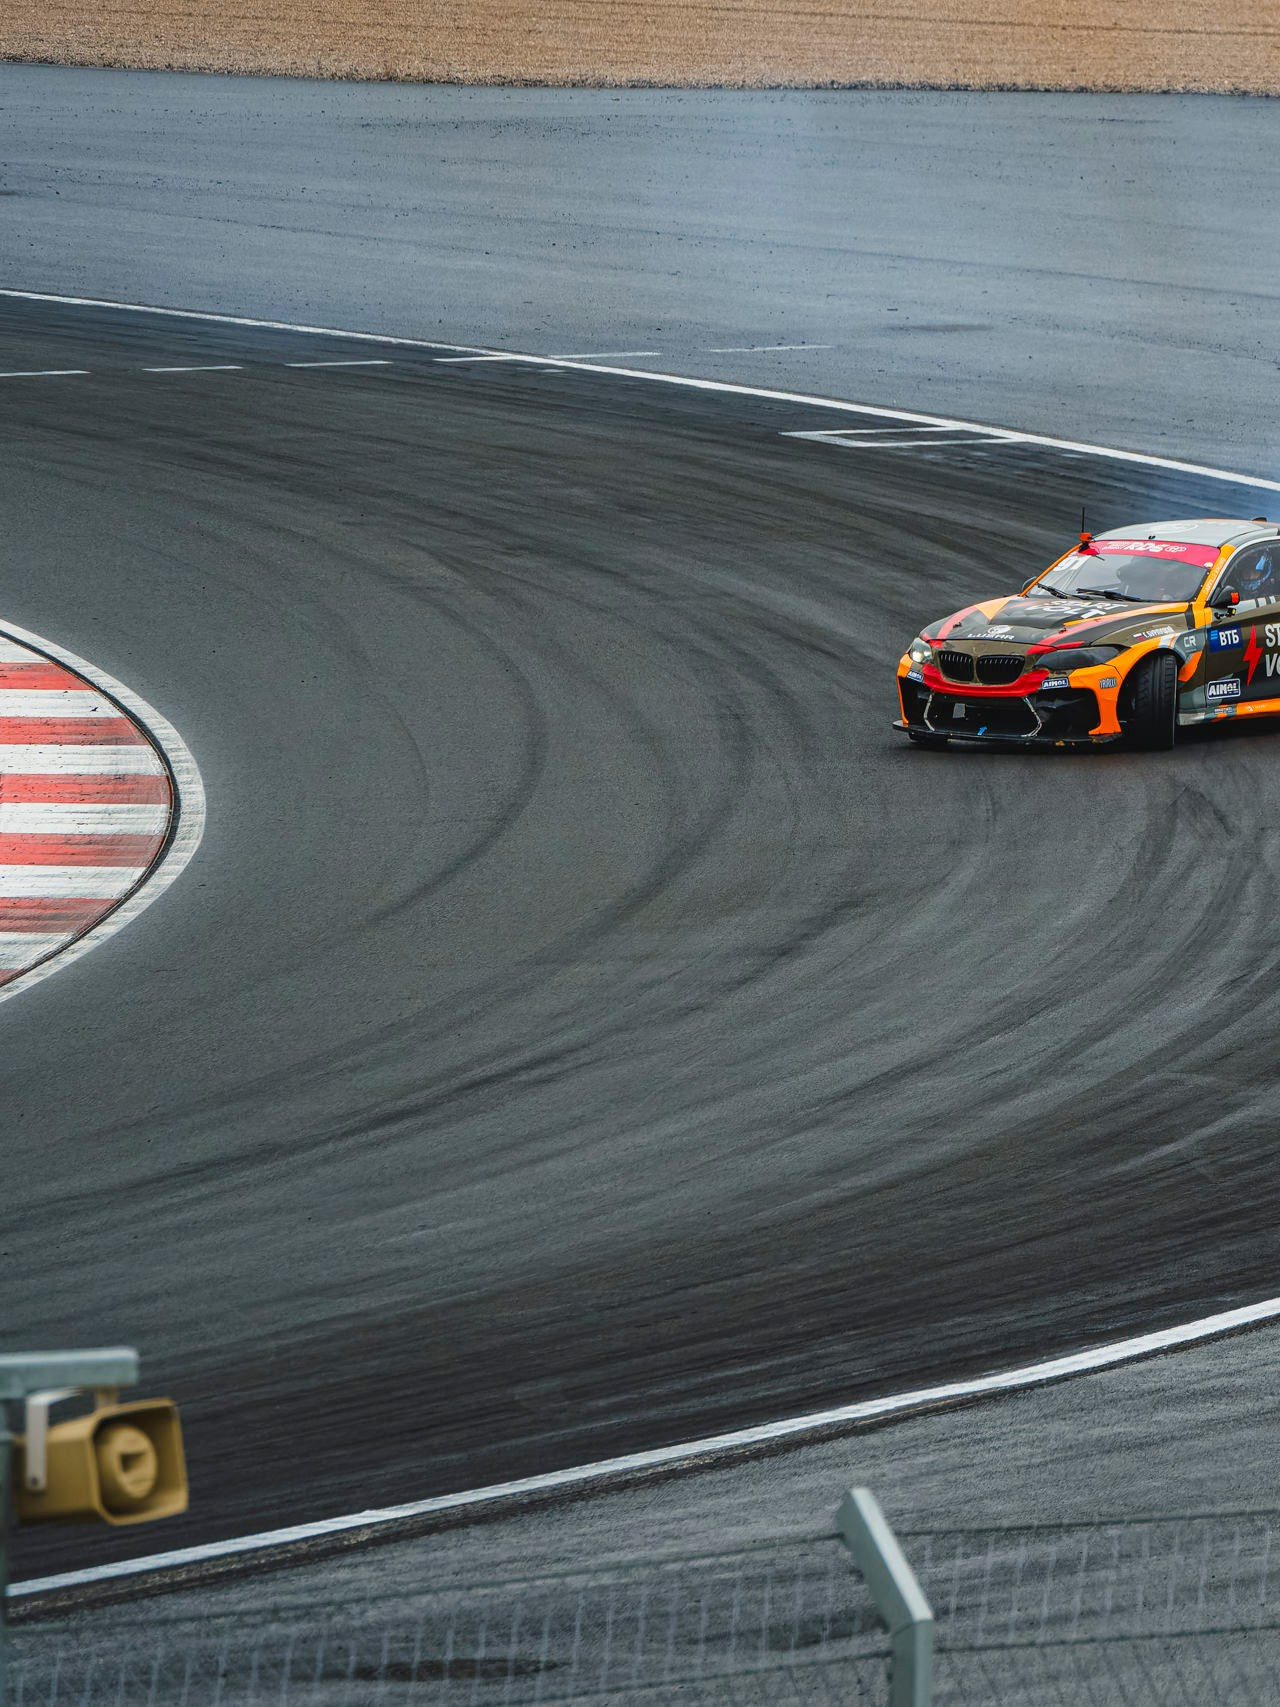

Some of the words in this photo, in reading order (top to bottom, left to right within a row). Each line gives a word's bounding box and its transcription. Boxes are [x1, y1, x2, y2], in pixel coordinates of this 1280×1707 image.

[1124, 541, 1168, 552] RDS
[1183, 635, 1197, 648] CR
[1218, 629, 1240, 647] ВТБ
[1208, 684, 1239, 697] AIMOL
